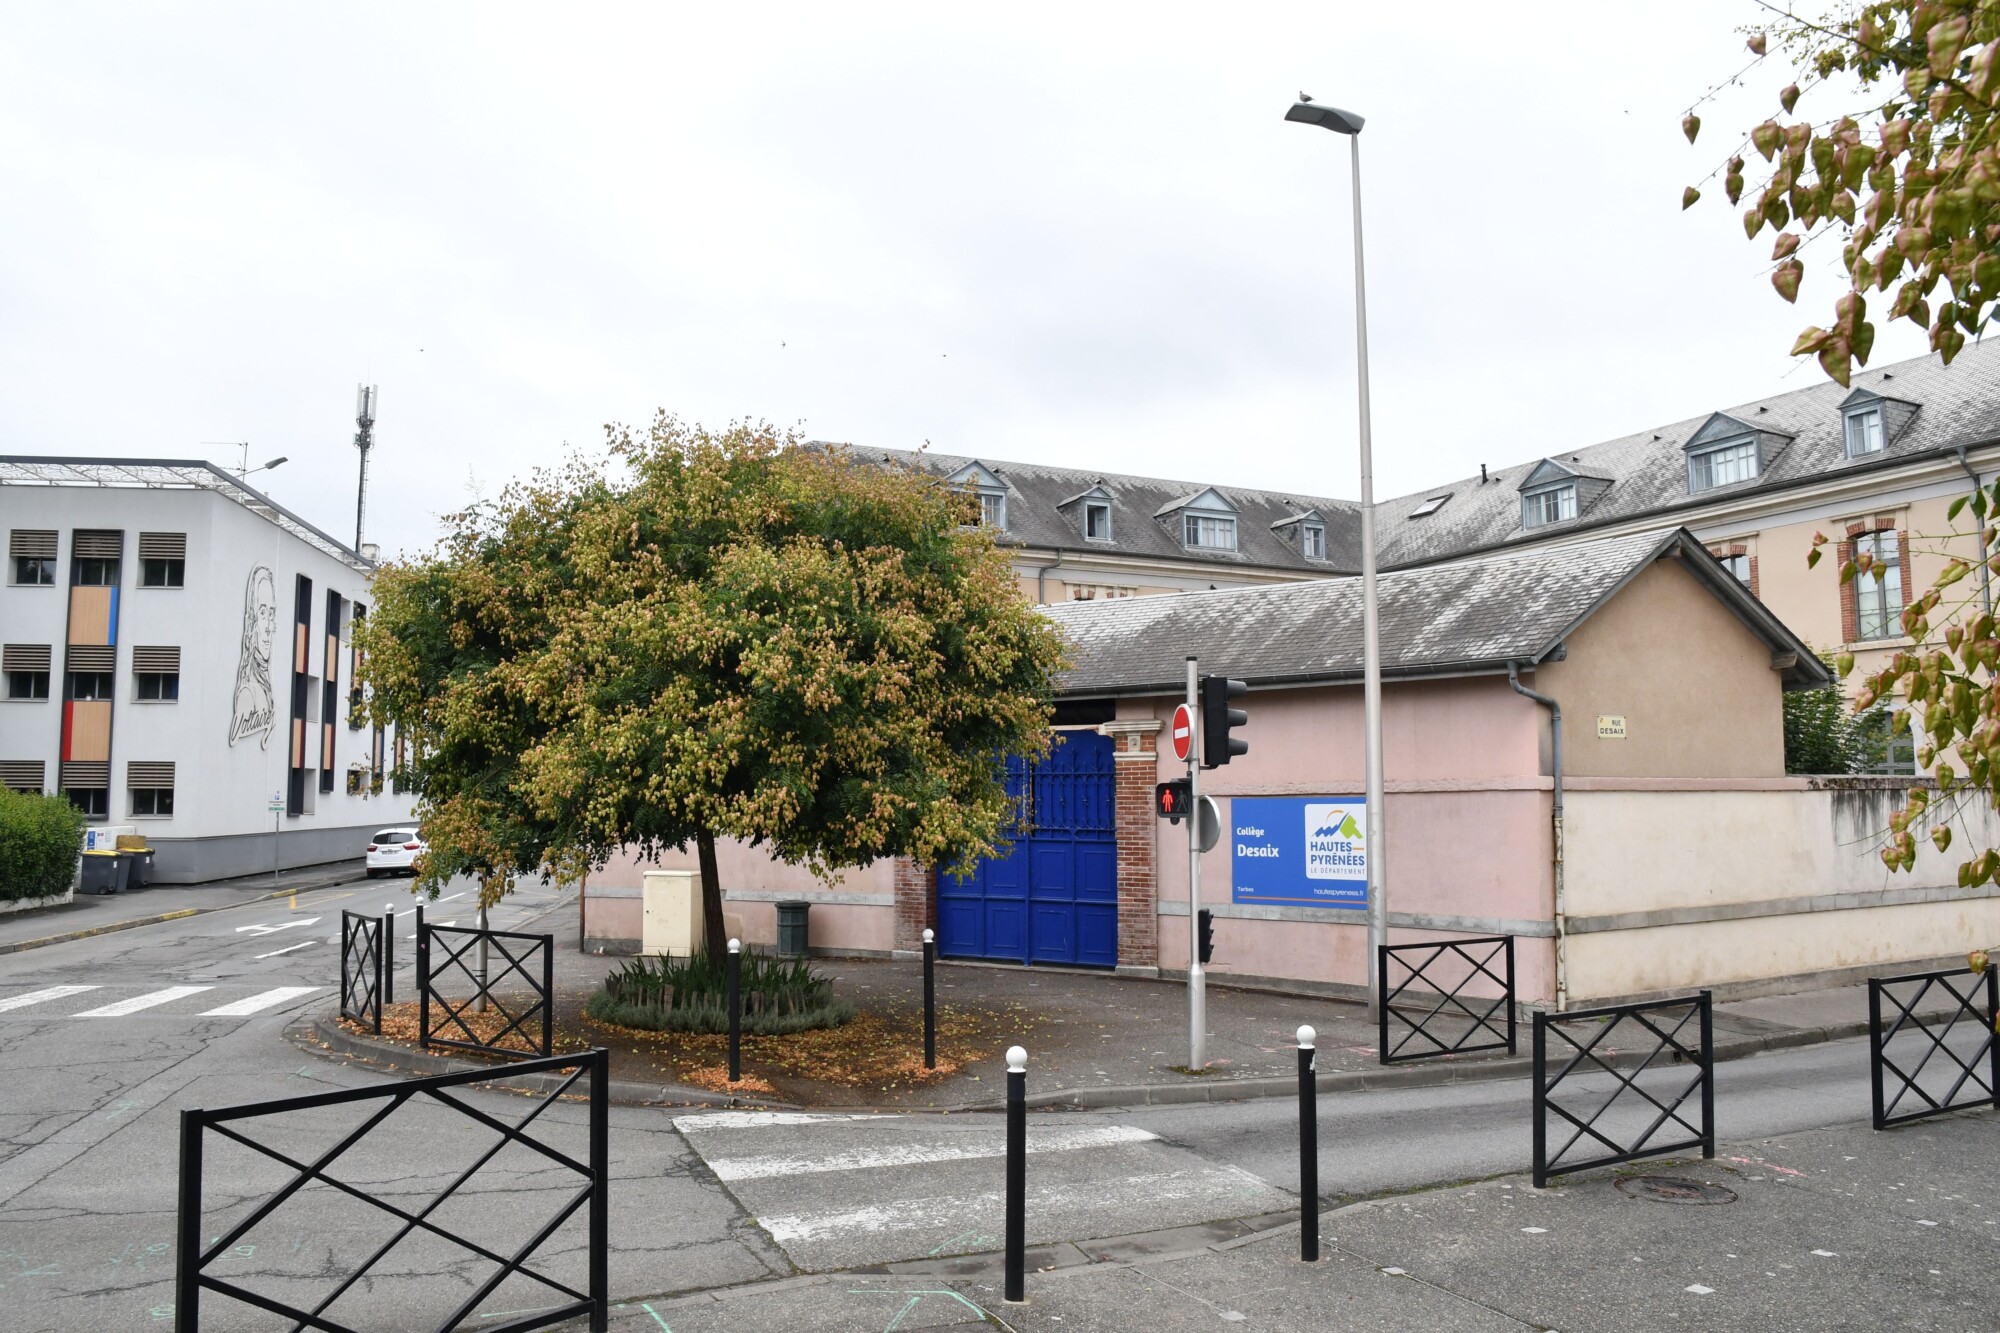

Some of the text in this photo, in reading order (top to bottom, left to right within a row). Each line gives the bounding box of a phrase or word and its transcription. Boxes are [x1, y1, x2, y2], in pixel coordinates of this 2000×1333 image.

[231, 705, 273, 742] Voltaire
[1237, 827, 1264, 837] Collège
[1237, 844, 1279, 857] Desaix
[1310, 853, 1365, 866] PYRÉNÉES
[1320, 866, 1365, 875] DÉPARTEMENT
[1313, 888, 1364, 897] hautespyrenees.fr
